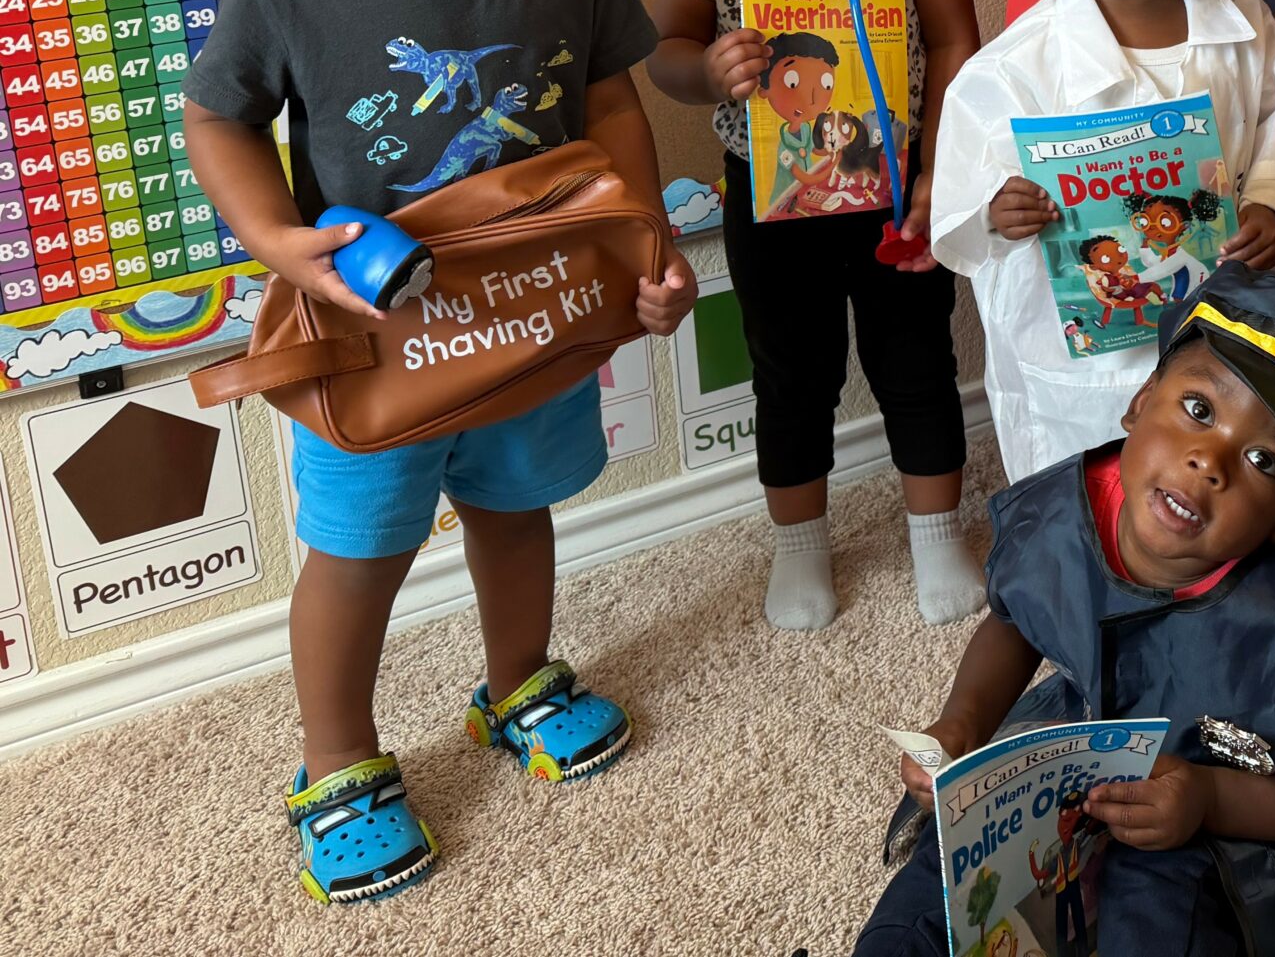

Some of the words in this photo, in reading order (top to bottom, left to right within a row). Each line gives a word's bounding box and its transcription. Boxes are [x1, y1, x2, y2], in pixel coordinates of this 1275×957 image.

[1052, 143, 1059, 156] I
[1062, 142, 1096, 156] Can
[1098, 129, 1146, 149] Read!
[1163, 116, 1173, 131] 1
[1090, 111, 1145, 126] COMMUNITY
[1057, 159, 1185, 207] Doctor
[1075, 164, 1082, 176] I
[1085, 159, 1124, 174] Want
[1129, 154, 1144, 165] to
[1149, 150, 1168, 161] Be
[1173, 147, 1183, 156] a
[79, 263, 111, 284] 95
[115, 256, 147, 277] 96
[152, 248, 181, 269] 97
[187, 241, 217, 261] 98
[420, 290, 475, 325] My
[479, 250, 571, 309] First
[403, 308, 555, 371] Shaving
[558, 278, 606, 326] Kit
[694, 416, 756, 452] Squ
[72, 544, 246, 614] Pentagon
[972, 783, 980, 799] I
[984, 765, 1020, 791] Can
[1025, 740, 1080, 767] Read!
[1103, 733, 1114, 746] 1
[985, 804, 990, 819] I
[995, 781, 1033, 811] Want
[1040, 770, 1056, 784] to
[1061, 763, 1083, 776] Be
[1089, 761, 1101, 770] a
[952, 807, 1024, 887] Police
